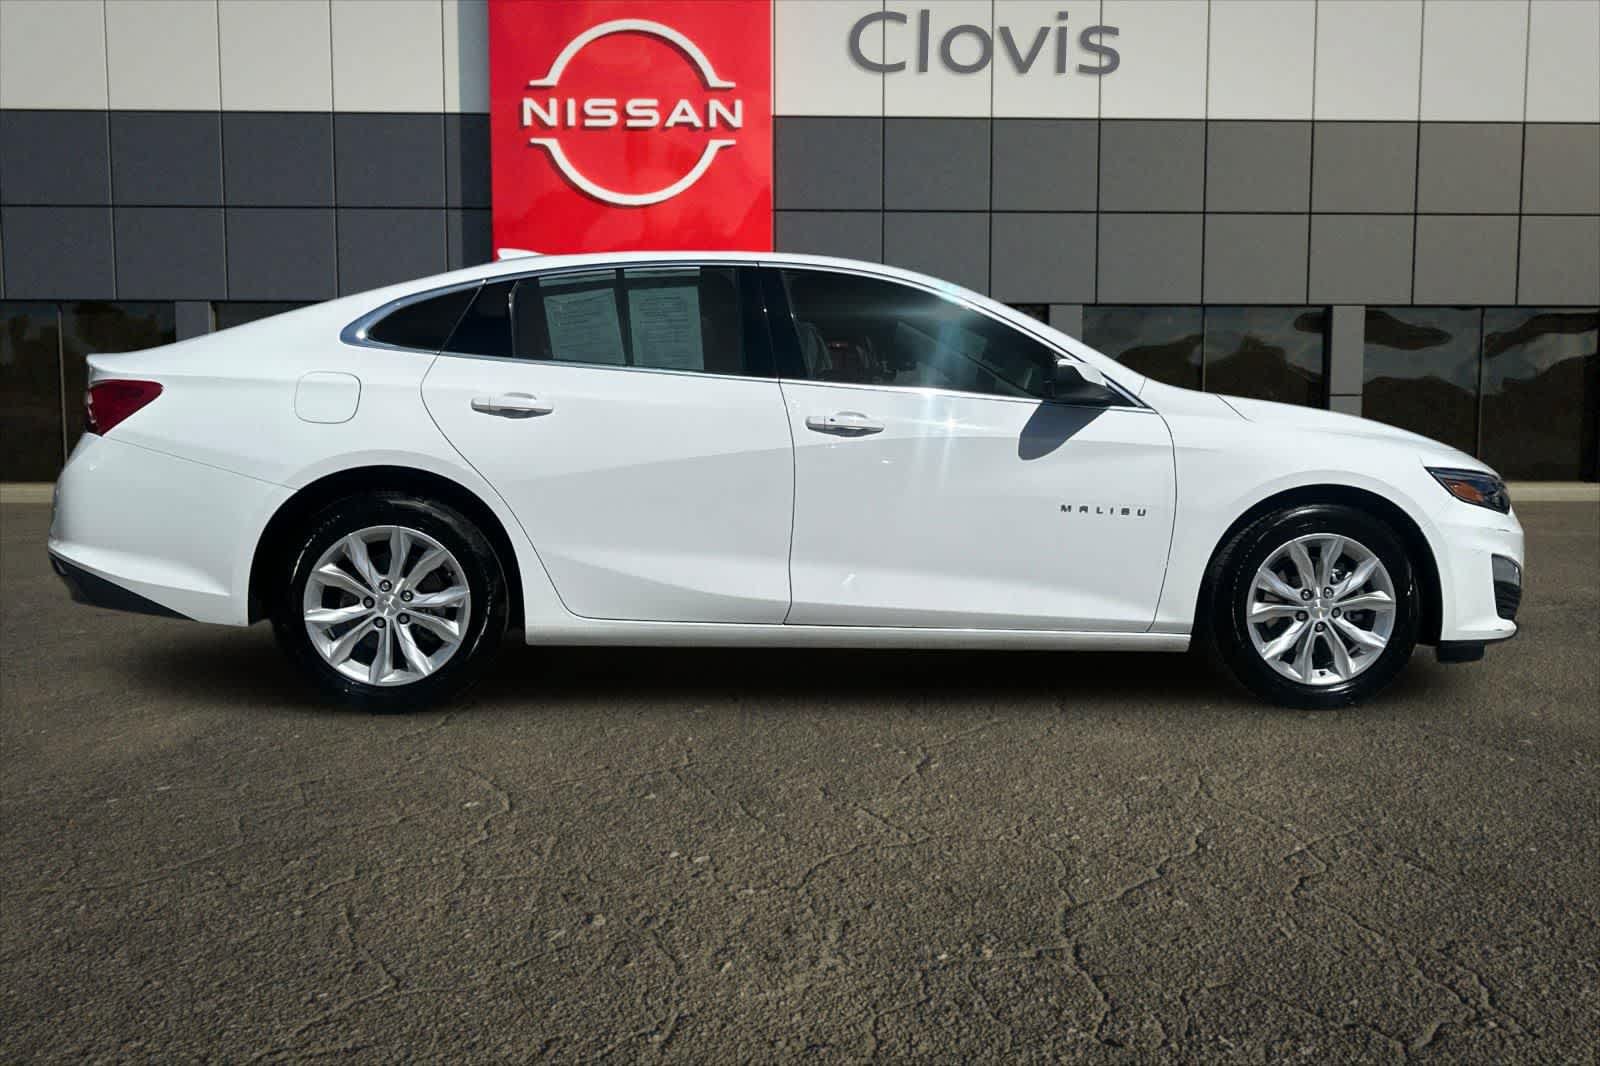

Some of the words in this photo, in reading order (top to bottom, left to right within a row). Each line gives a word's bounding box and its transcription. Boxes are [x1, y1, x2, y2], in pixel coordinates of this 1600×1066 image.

[849, 9, 1121, 75] Clovis
[522, 97, 744, 130] NISSAN
[1060, 504, 1147, 517] MALIBU
